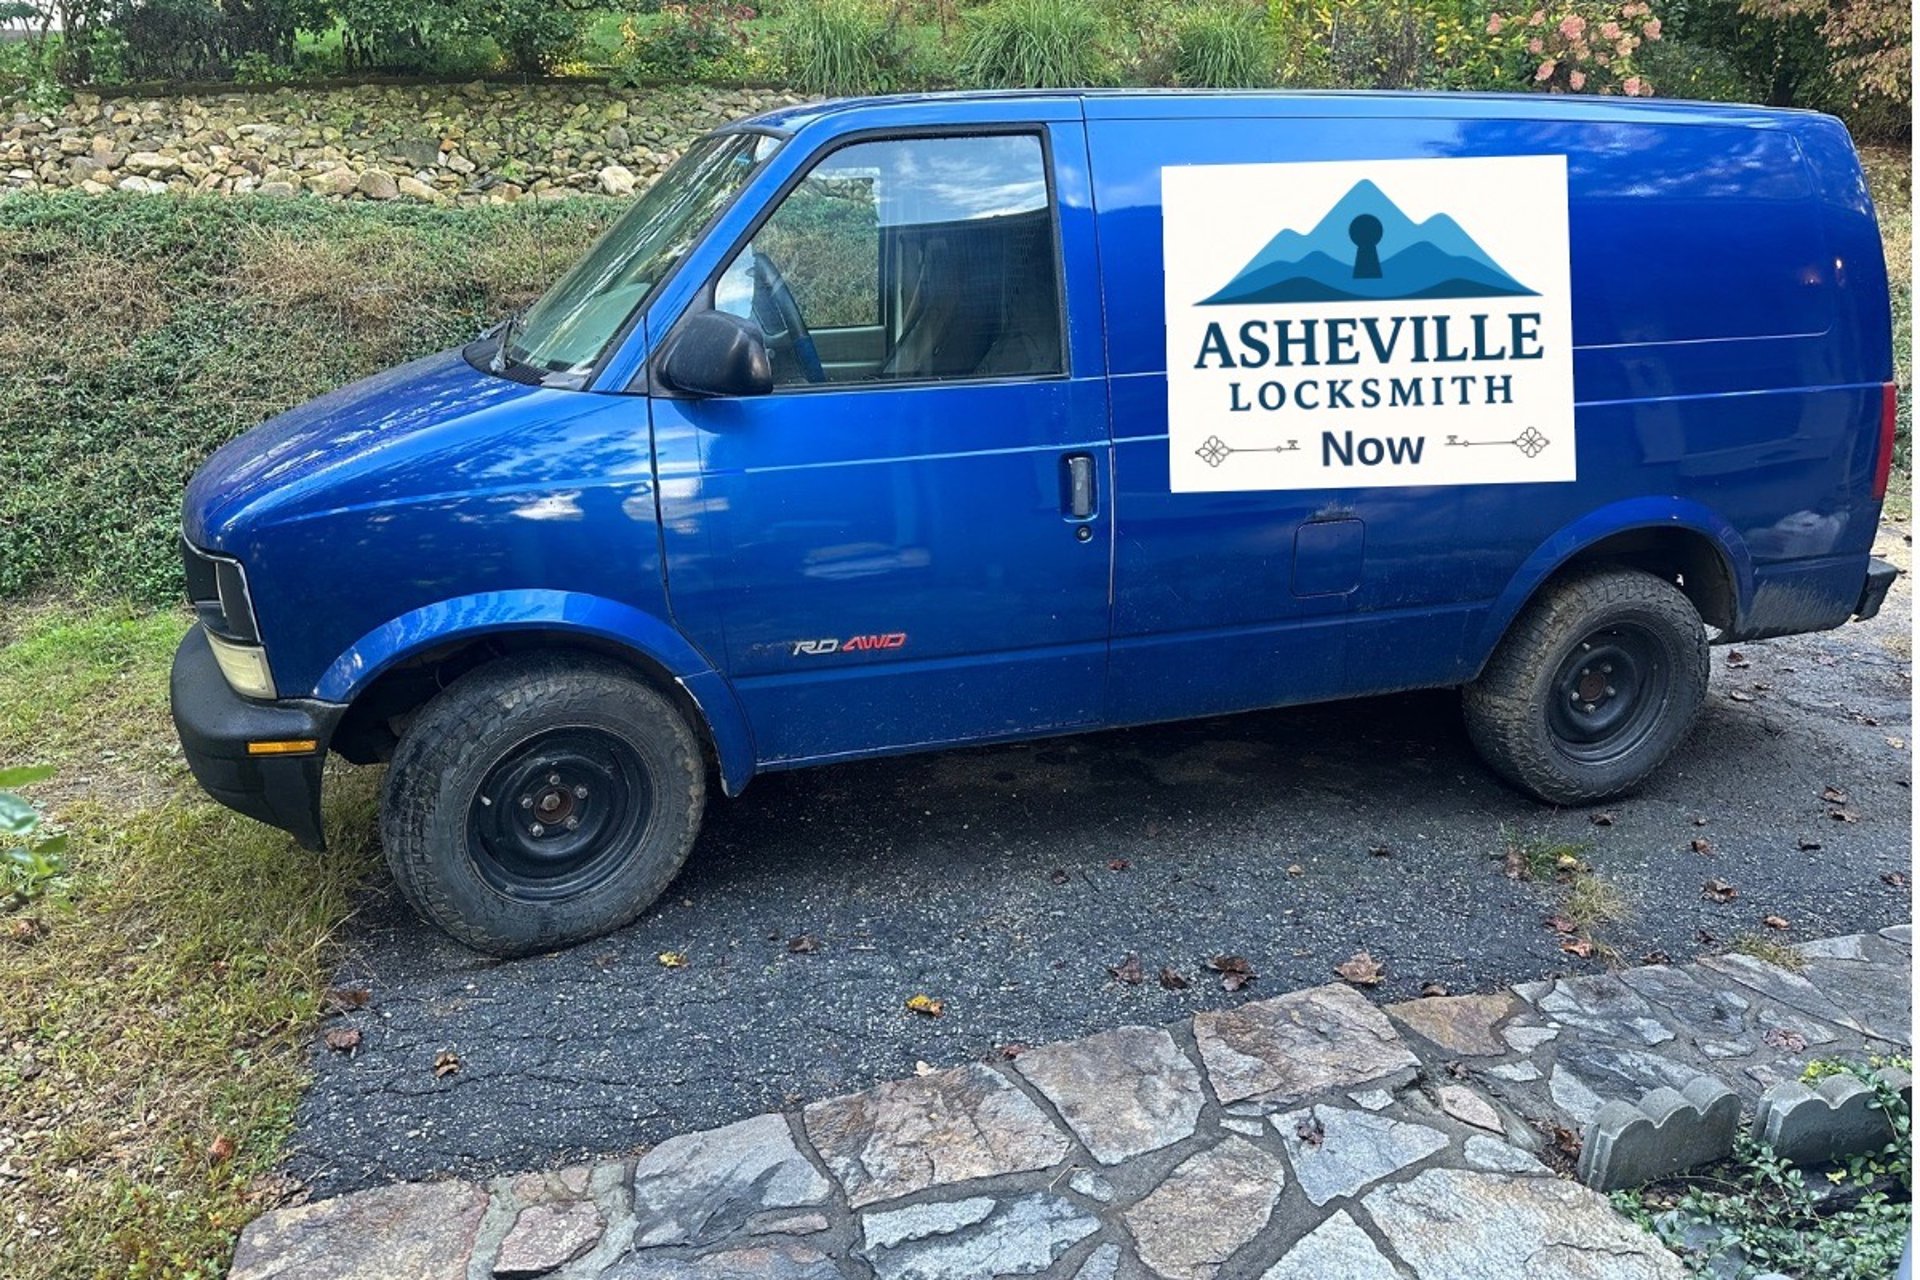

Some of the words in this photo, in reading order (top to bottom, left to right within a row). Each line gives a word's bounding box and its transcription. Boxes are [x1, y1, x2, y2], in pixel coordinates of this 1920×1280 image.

[1193, 312, 1545, 369] ASHEVILLE
[1229, 374, 1514, 412] LOCKSMITH
[1321, 430, 1425, 467] Now
[842, 632, 907, 652] AWD
